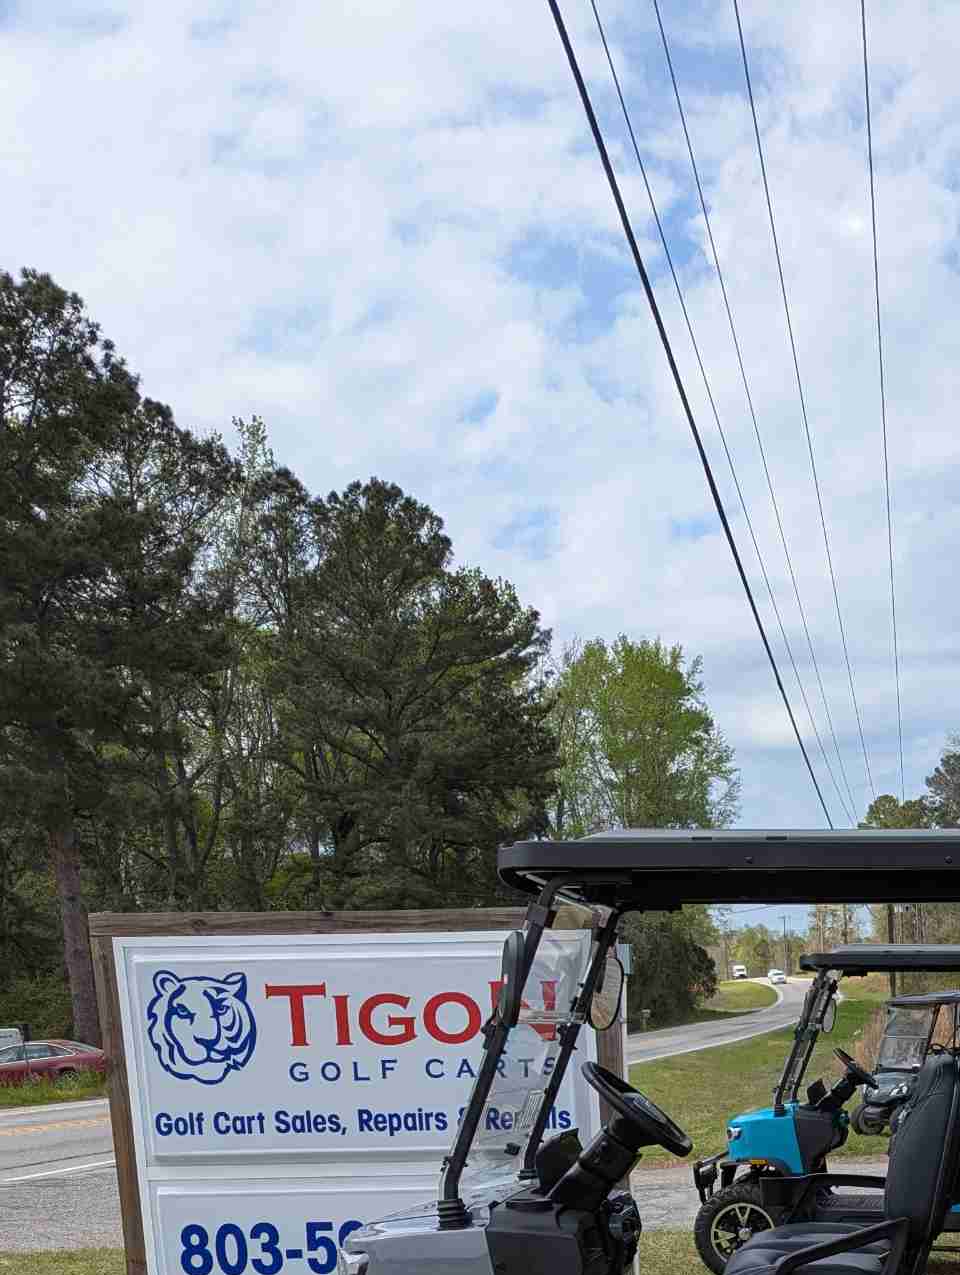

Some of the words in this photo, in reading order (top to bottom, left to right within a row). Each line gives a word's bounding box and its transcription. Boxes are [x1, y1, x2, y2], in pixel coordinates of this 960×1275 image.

[289, 1059, 397, 1082] GOLF
[425, 1058, 556, 1078] CARTS
[155, 1112, 204, 1136] Golf
[213, 1111, 265, 1135] Cart
[274, 1110, 347, 1135] Sales,
[357, 1108, 448, 1136] Repairs
